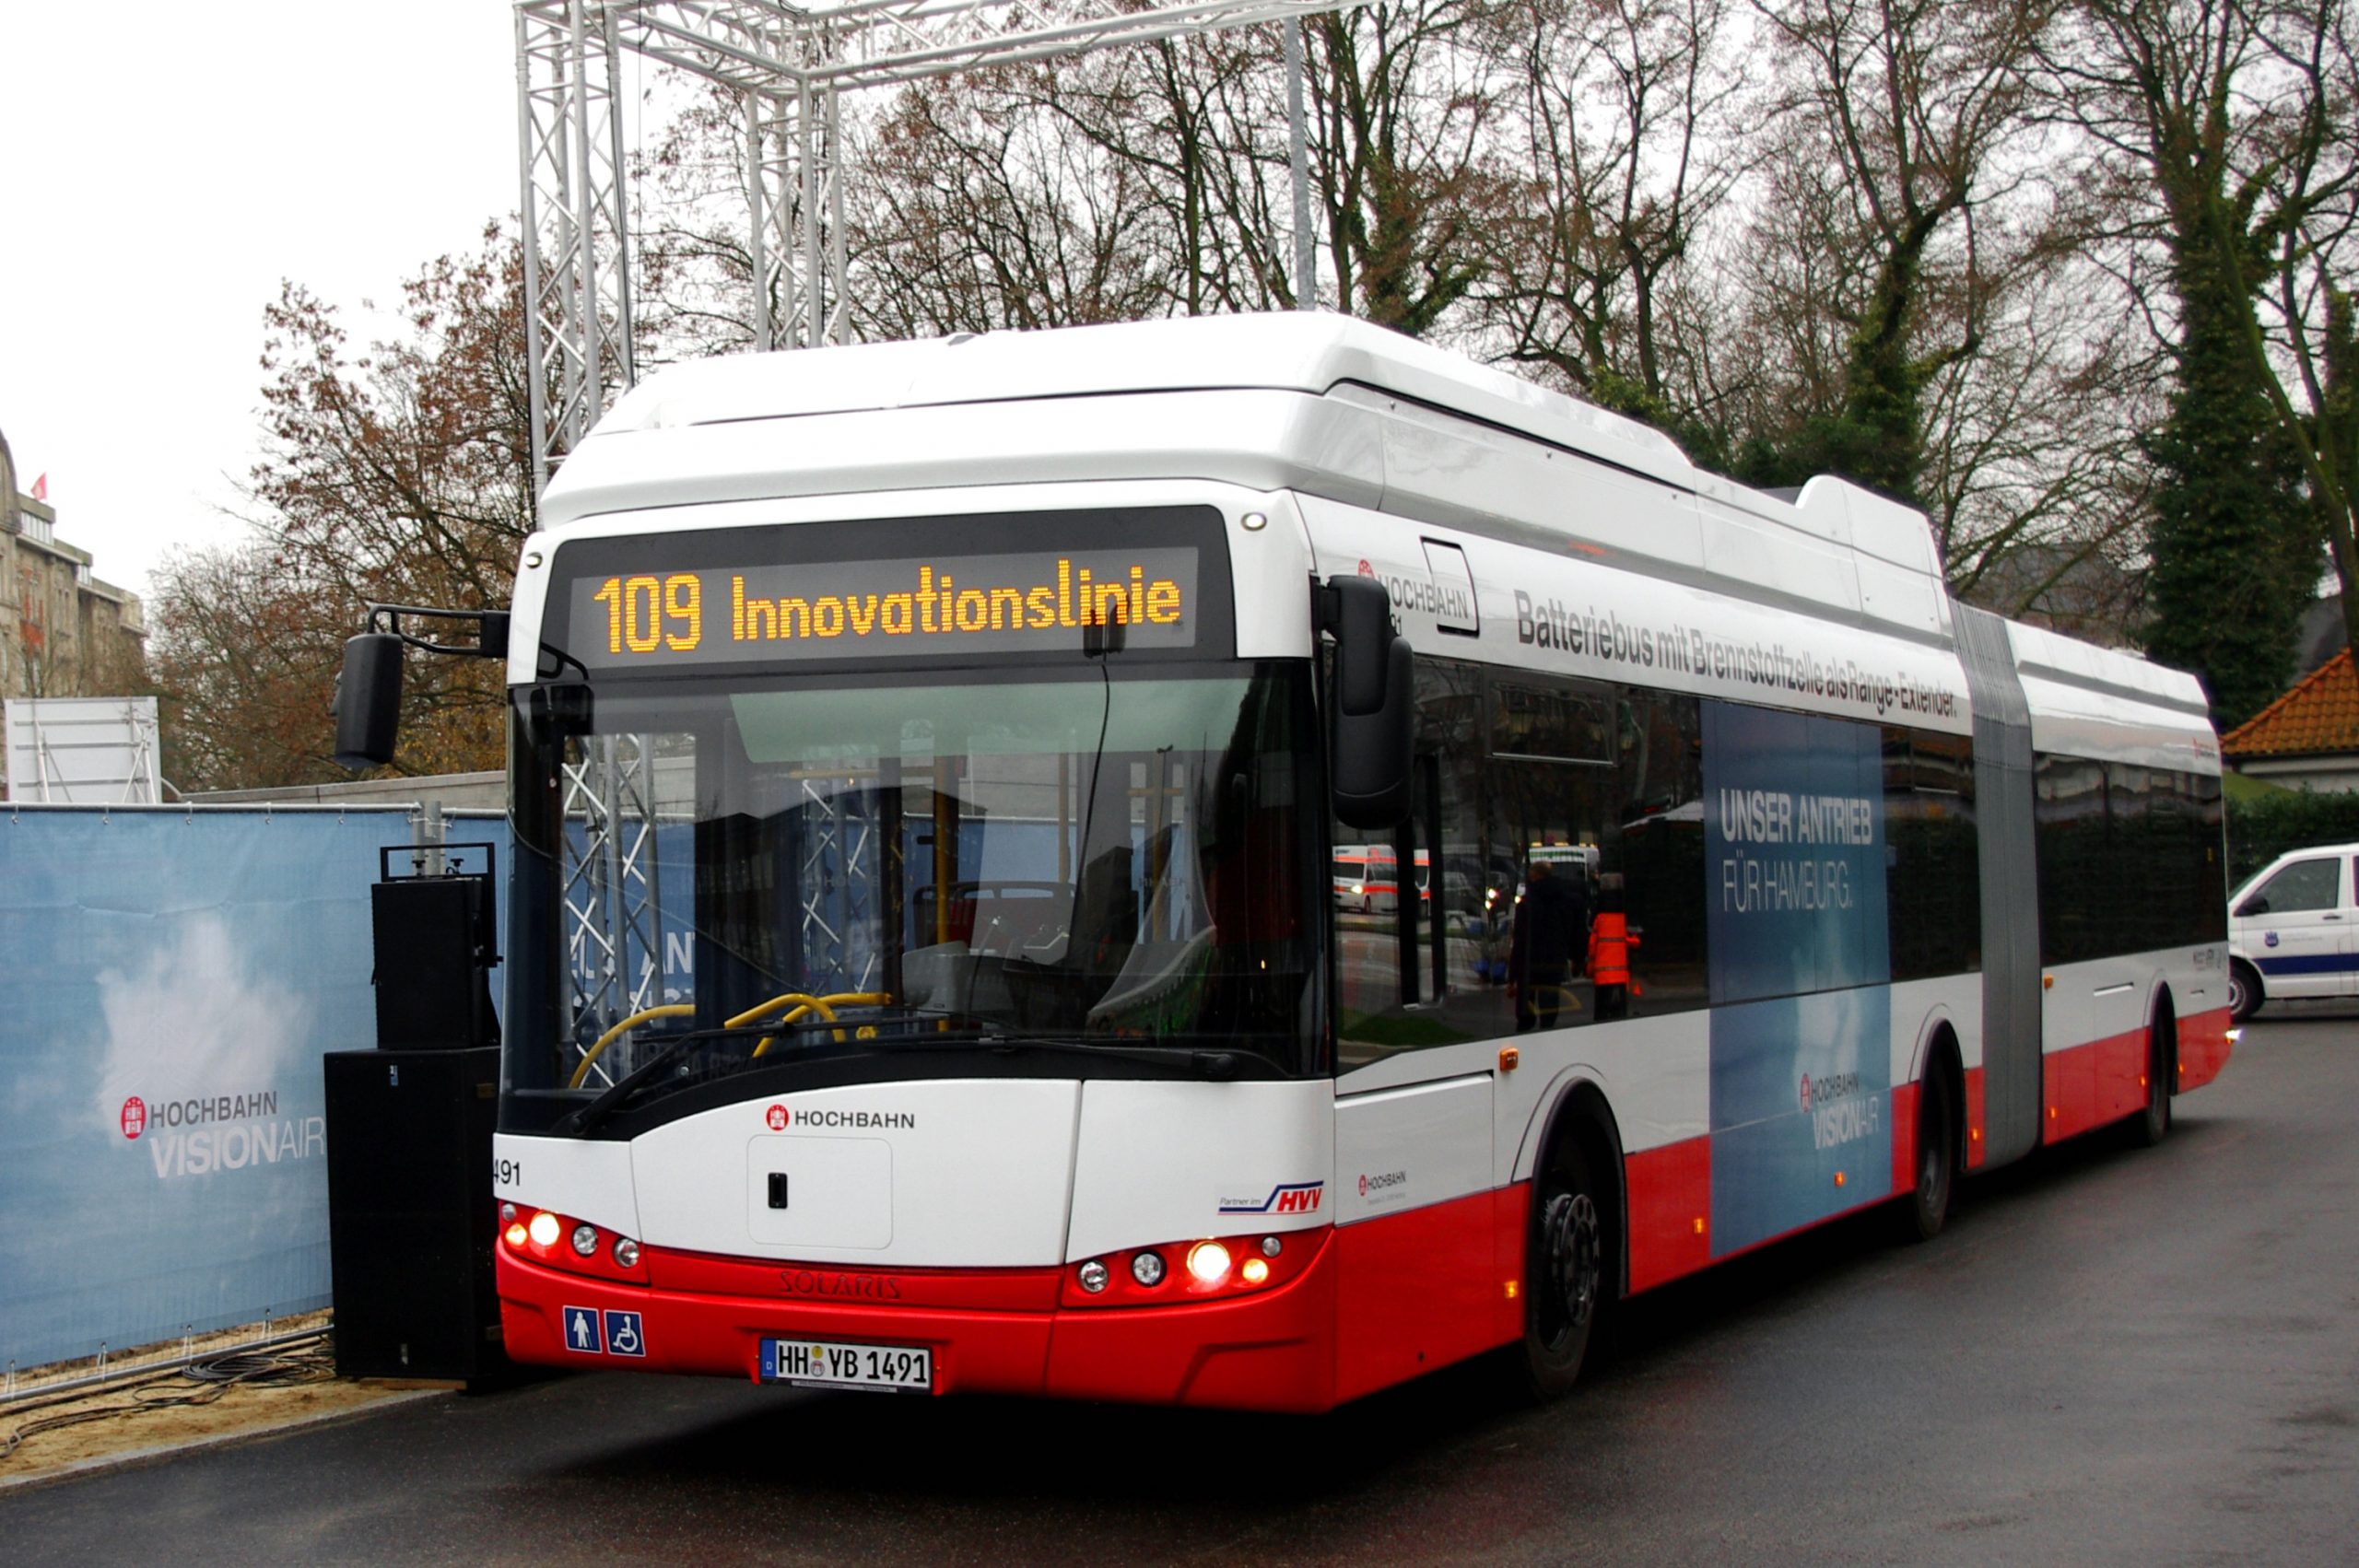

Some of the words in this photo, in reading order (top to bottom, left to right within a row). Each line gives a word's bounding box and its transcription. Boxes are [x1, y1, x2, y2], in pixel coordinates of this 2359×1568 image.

[593, 575, 701, 653] 109
[732, 558, 1180, 640] Innovationslinie
[1390, 614, 1402, 636] 91
[1514, 589, 1653, 666] Batteriebus
[1656, 623, 1689, 673] mit
[1690, 628, 1824, 696] Brennstoffzelle
[1720, 788, 1792, 844] UNSER
[1798, 794, 1872, 845] ANTRIEB
[1723, 849, 1760, 913] FÜR
[1811, 1071, 1860, 1103] HOCHBAHN
[150, 1091, 277, 1129] HOCHBAHN
[794, 1110, 915, 1129] HOCHBAHN
[1813, 1095, 1879, 1150] VISIONAIR
[149, 1117, 325, 1179] VISIONAIR
[1276, 1188, 1323, 1212] HVV
[1367, 1171, 1407, 1191] HOCHBAHN
[780, 1271, 900, 1300] SOLARIS
[766, 1362, 773, 1371] D
[778, 1345, 808, 1375] HH
[827, 1348, 858, 1378] YB
[866, 1351, 927, 1383] 1491
